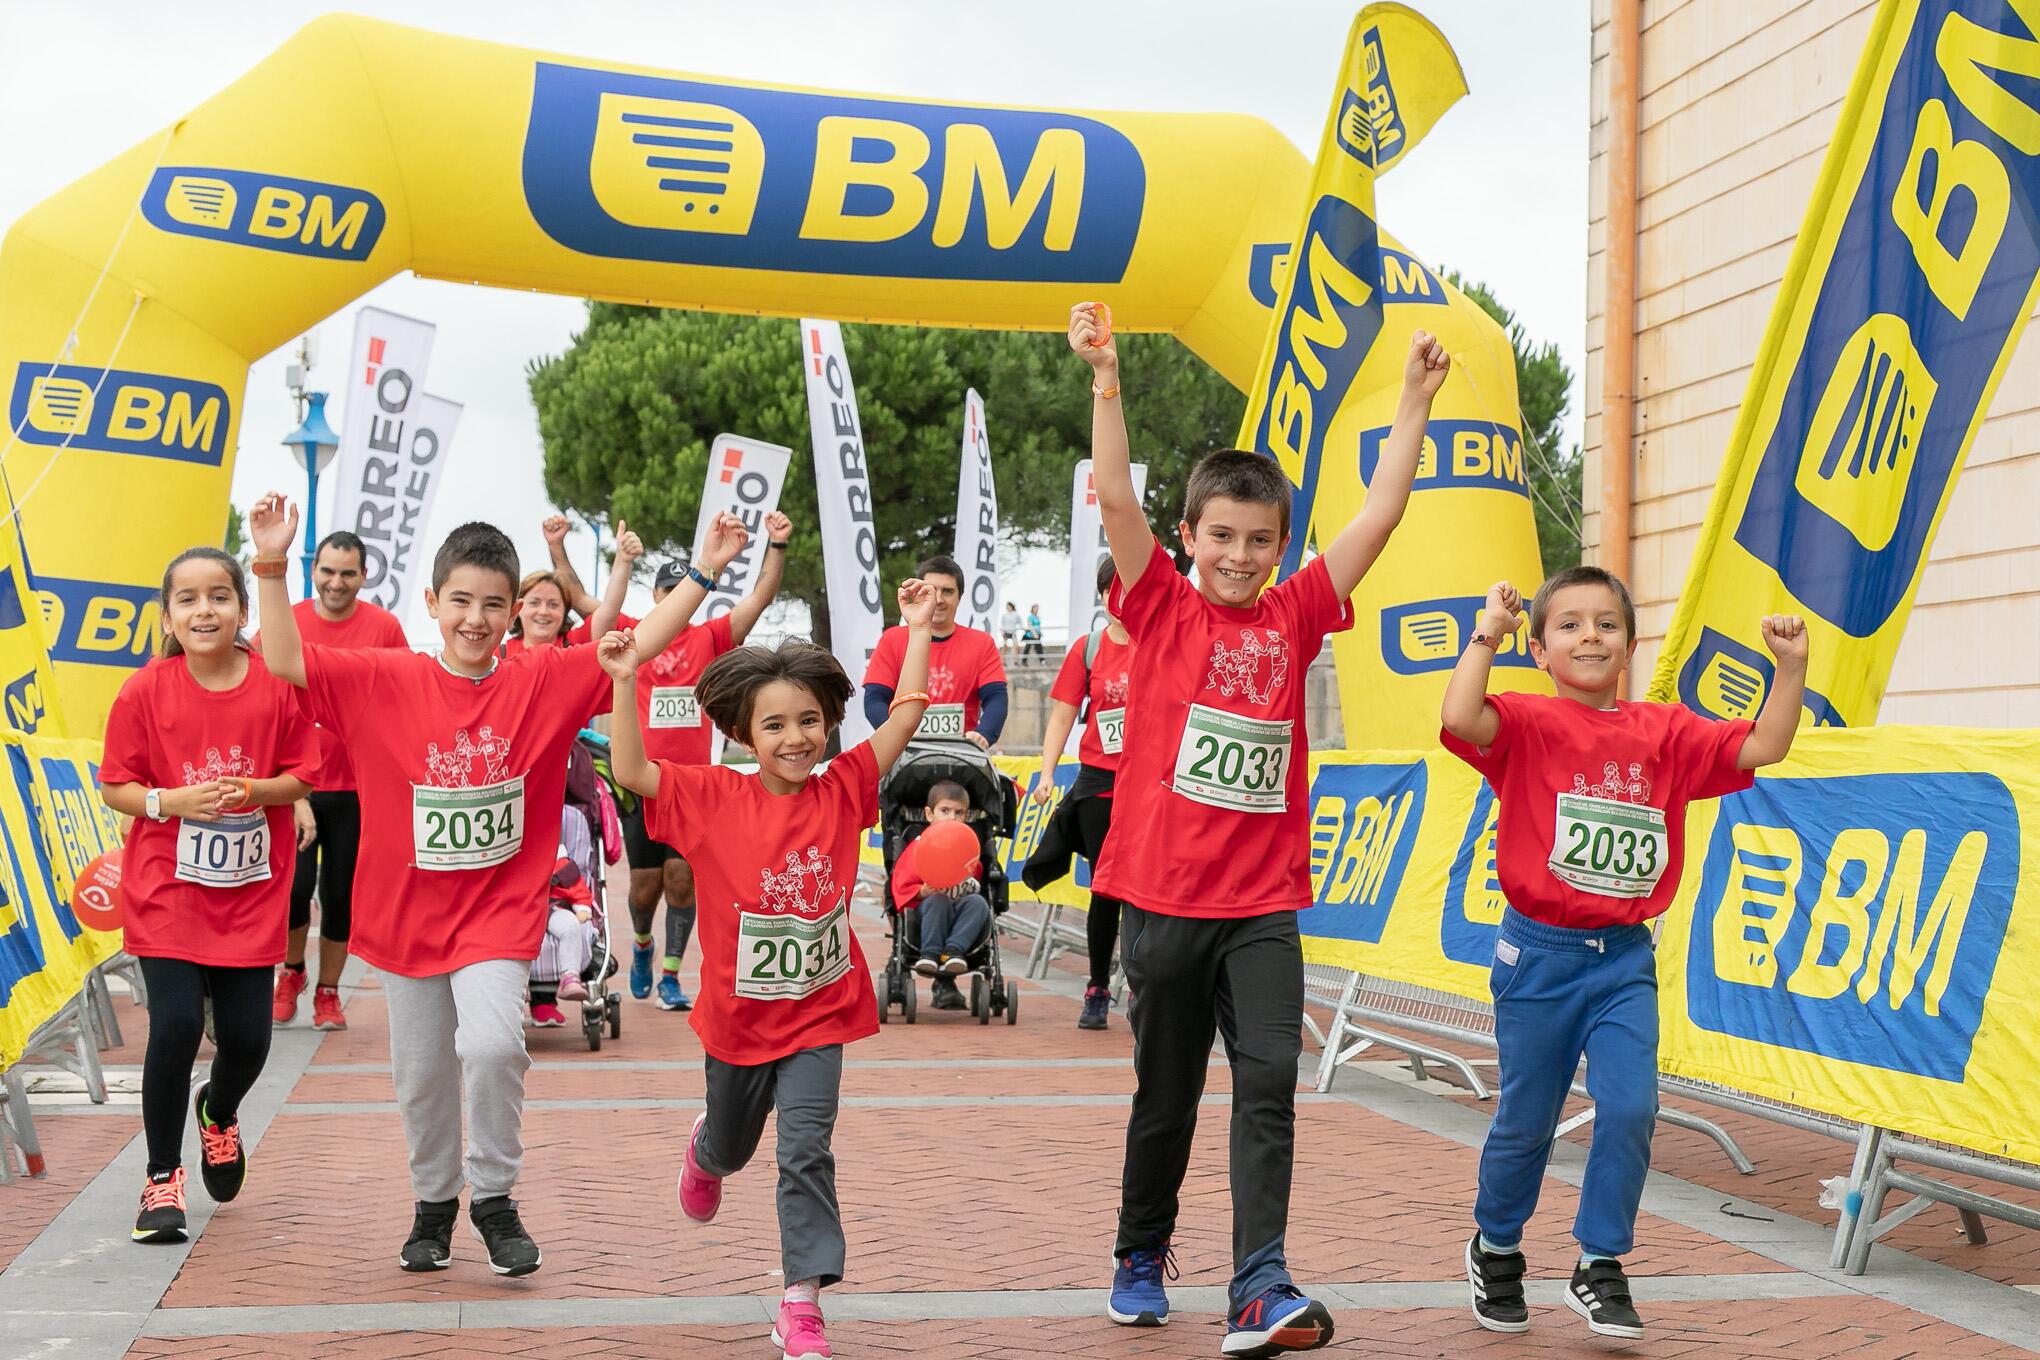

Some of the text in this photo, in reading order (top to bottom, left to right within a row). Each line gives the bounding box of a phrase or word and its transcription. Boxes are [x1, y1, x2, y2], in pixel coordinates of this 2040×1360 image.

[1369, 84, 1402, 150] BM
[799, 115, 1086, 252] BM
[248, 186, 369, 251] BM
[1381, 255, 1431, 296] M
[1268, 230, 1373, 490] BM
[106, 385, 220, 452] BM
[355, 368, 412, 608] ORREO
[826, 354, 882, 615] CORREO
[1453, 431, 1524, 486] BM
[656, 698, 696, 717] 2034
[920, 714, 960, 734] 2033
[1188, 735, 1283, 790] 2033
[190, 830, 263, 869] 1013
[426, 802, 514, 849] 2034
[1325, 790, 1414, 905] BM
[1563, 823, 1657, 877] 2033
[751, 924, 841, 979] 2034
[1786, 828, 1988, 1017] BM
